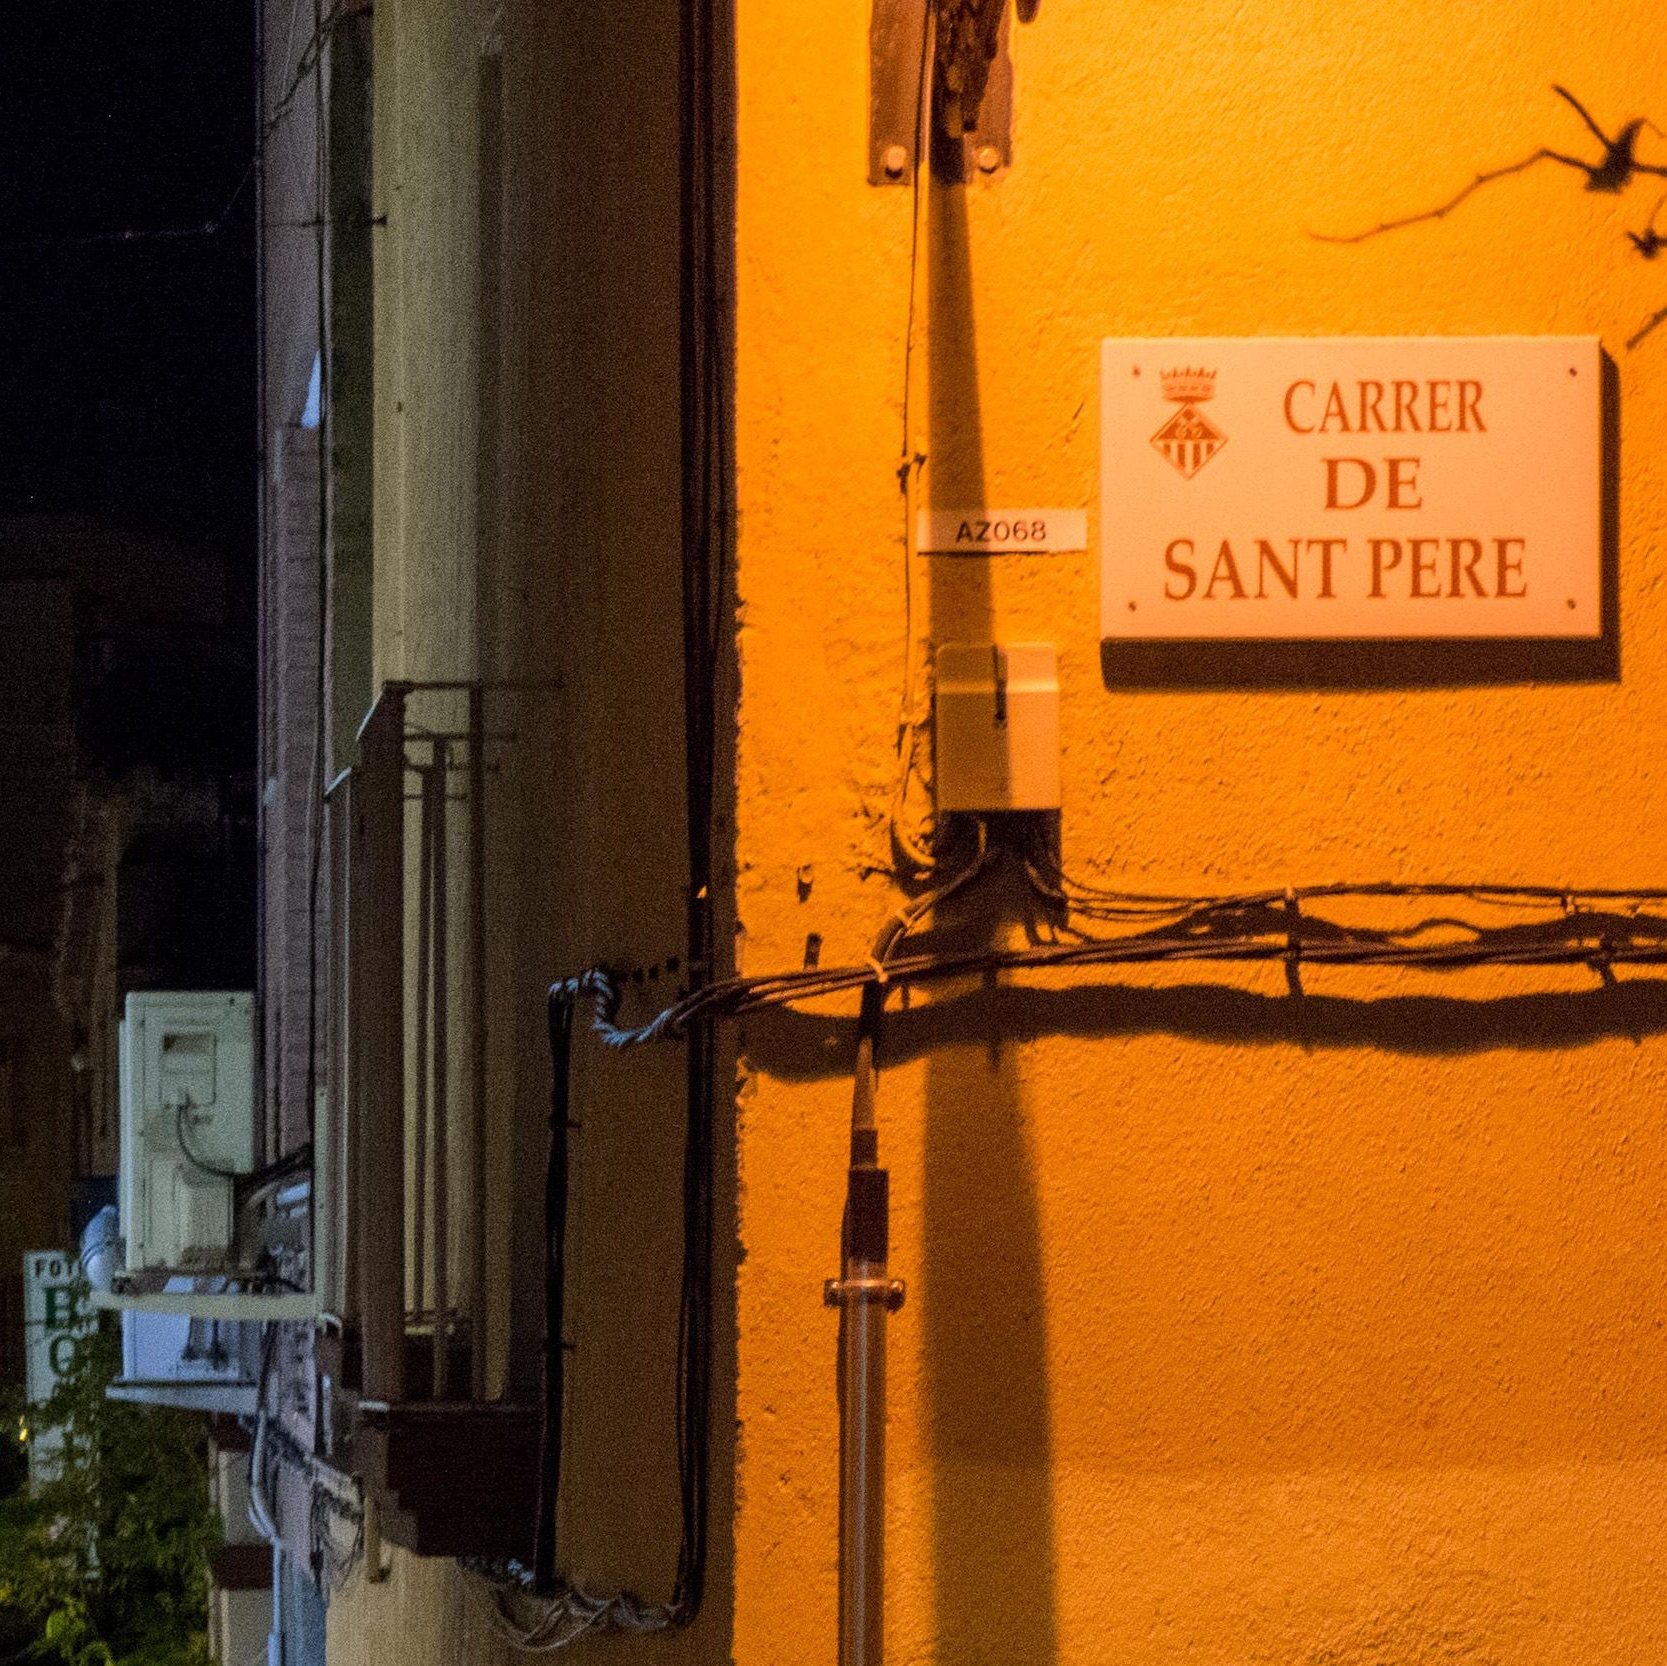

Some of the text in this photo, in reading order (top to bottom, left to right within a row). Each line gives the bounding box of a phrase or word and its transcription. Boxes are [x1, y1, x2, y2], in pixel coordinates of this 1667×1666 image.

[1283, 379, 1488, 434] CARRER
[1322, 457, 1423, 510] DE
[1163, 537, 1528, 601] SANT PERE
